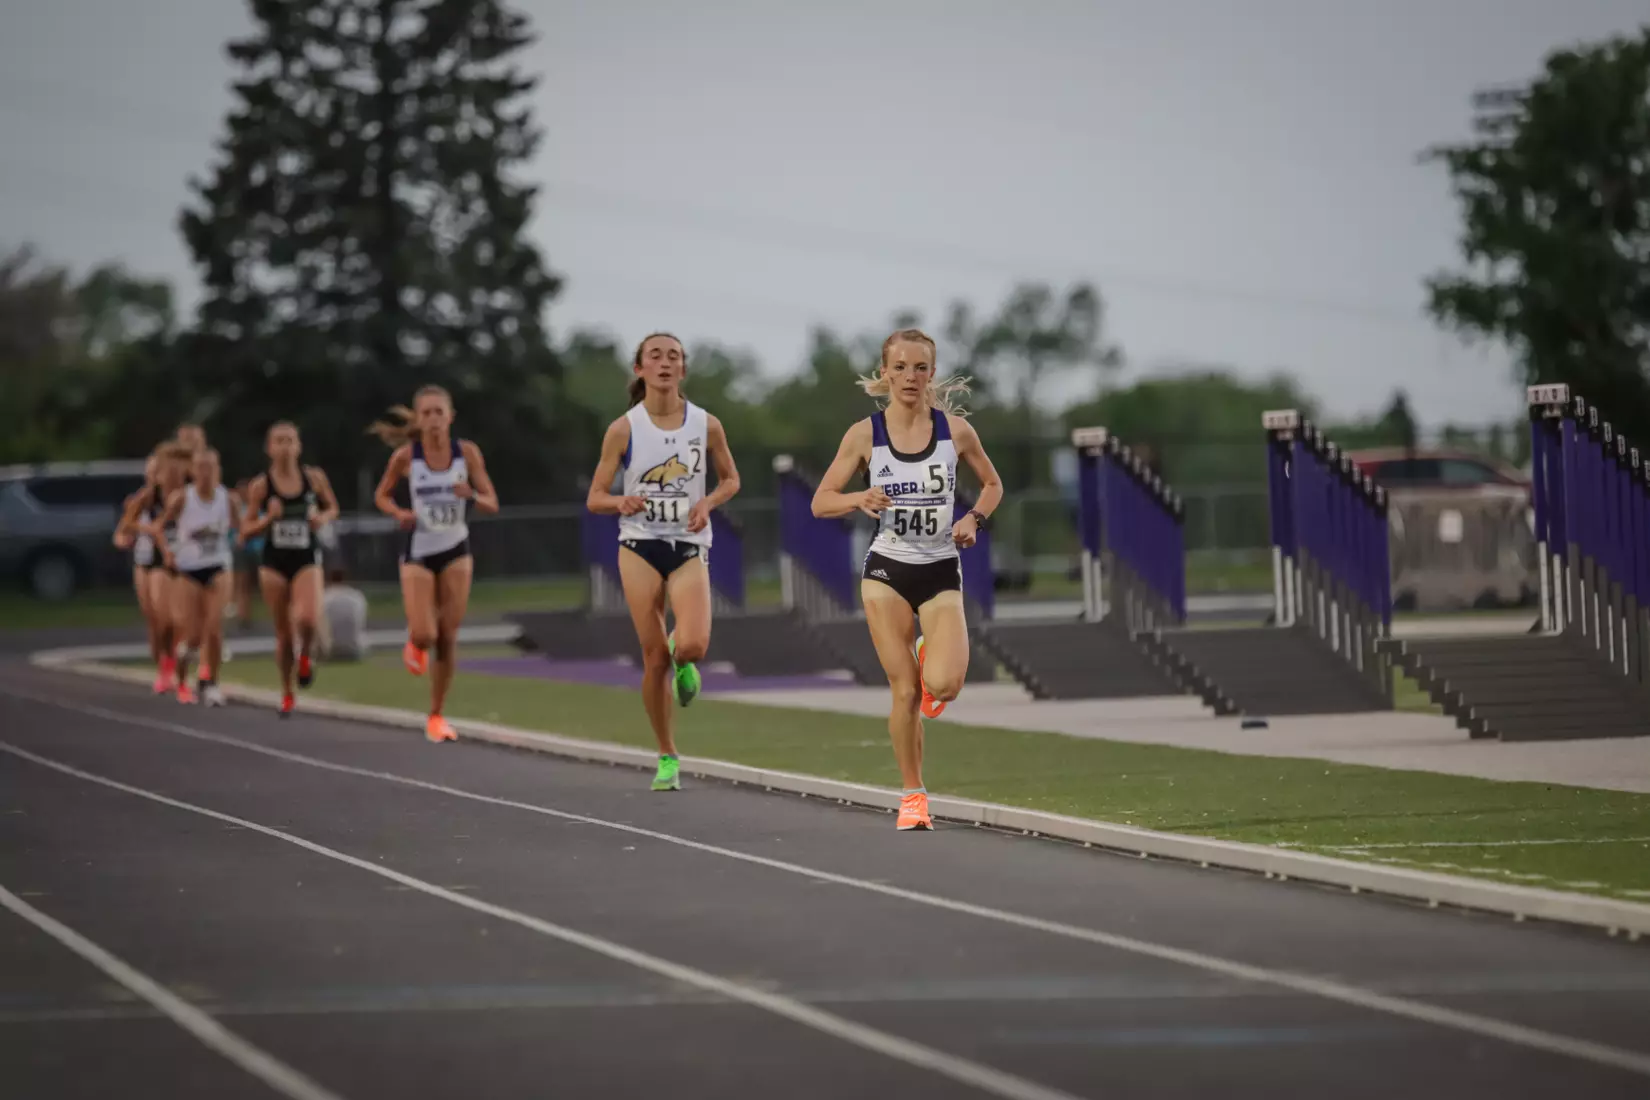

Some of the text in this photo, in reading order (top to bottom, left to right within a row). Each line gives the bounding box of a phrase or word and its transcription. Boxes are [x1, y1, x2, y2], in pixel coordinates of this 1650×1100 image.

[691, 447, 701, 473] 2
[879, 481, 918, 497] EBER
[928, 464, 945, 494] 5
[646, 499, 680, 522] 311
[895, 508, 937, 536] 545
